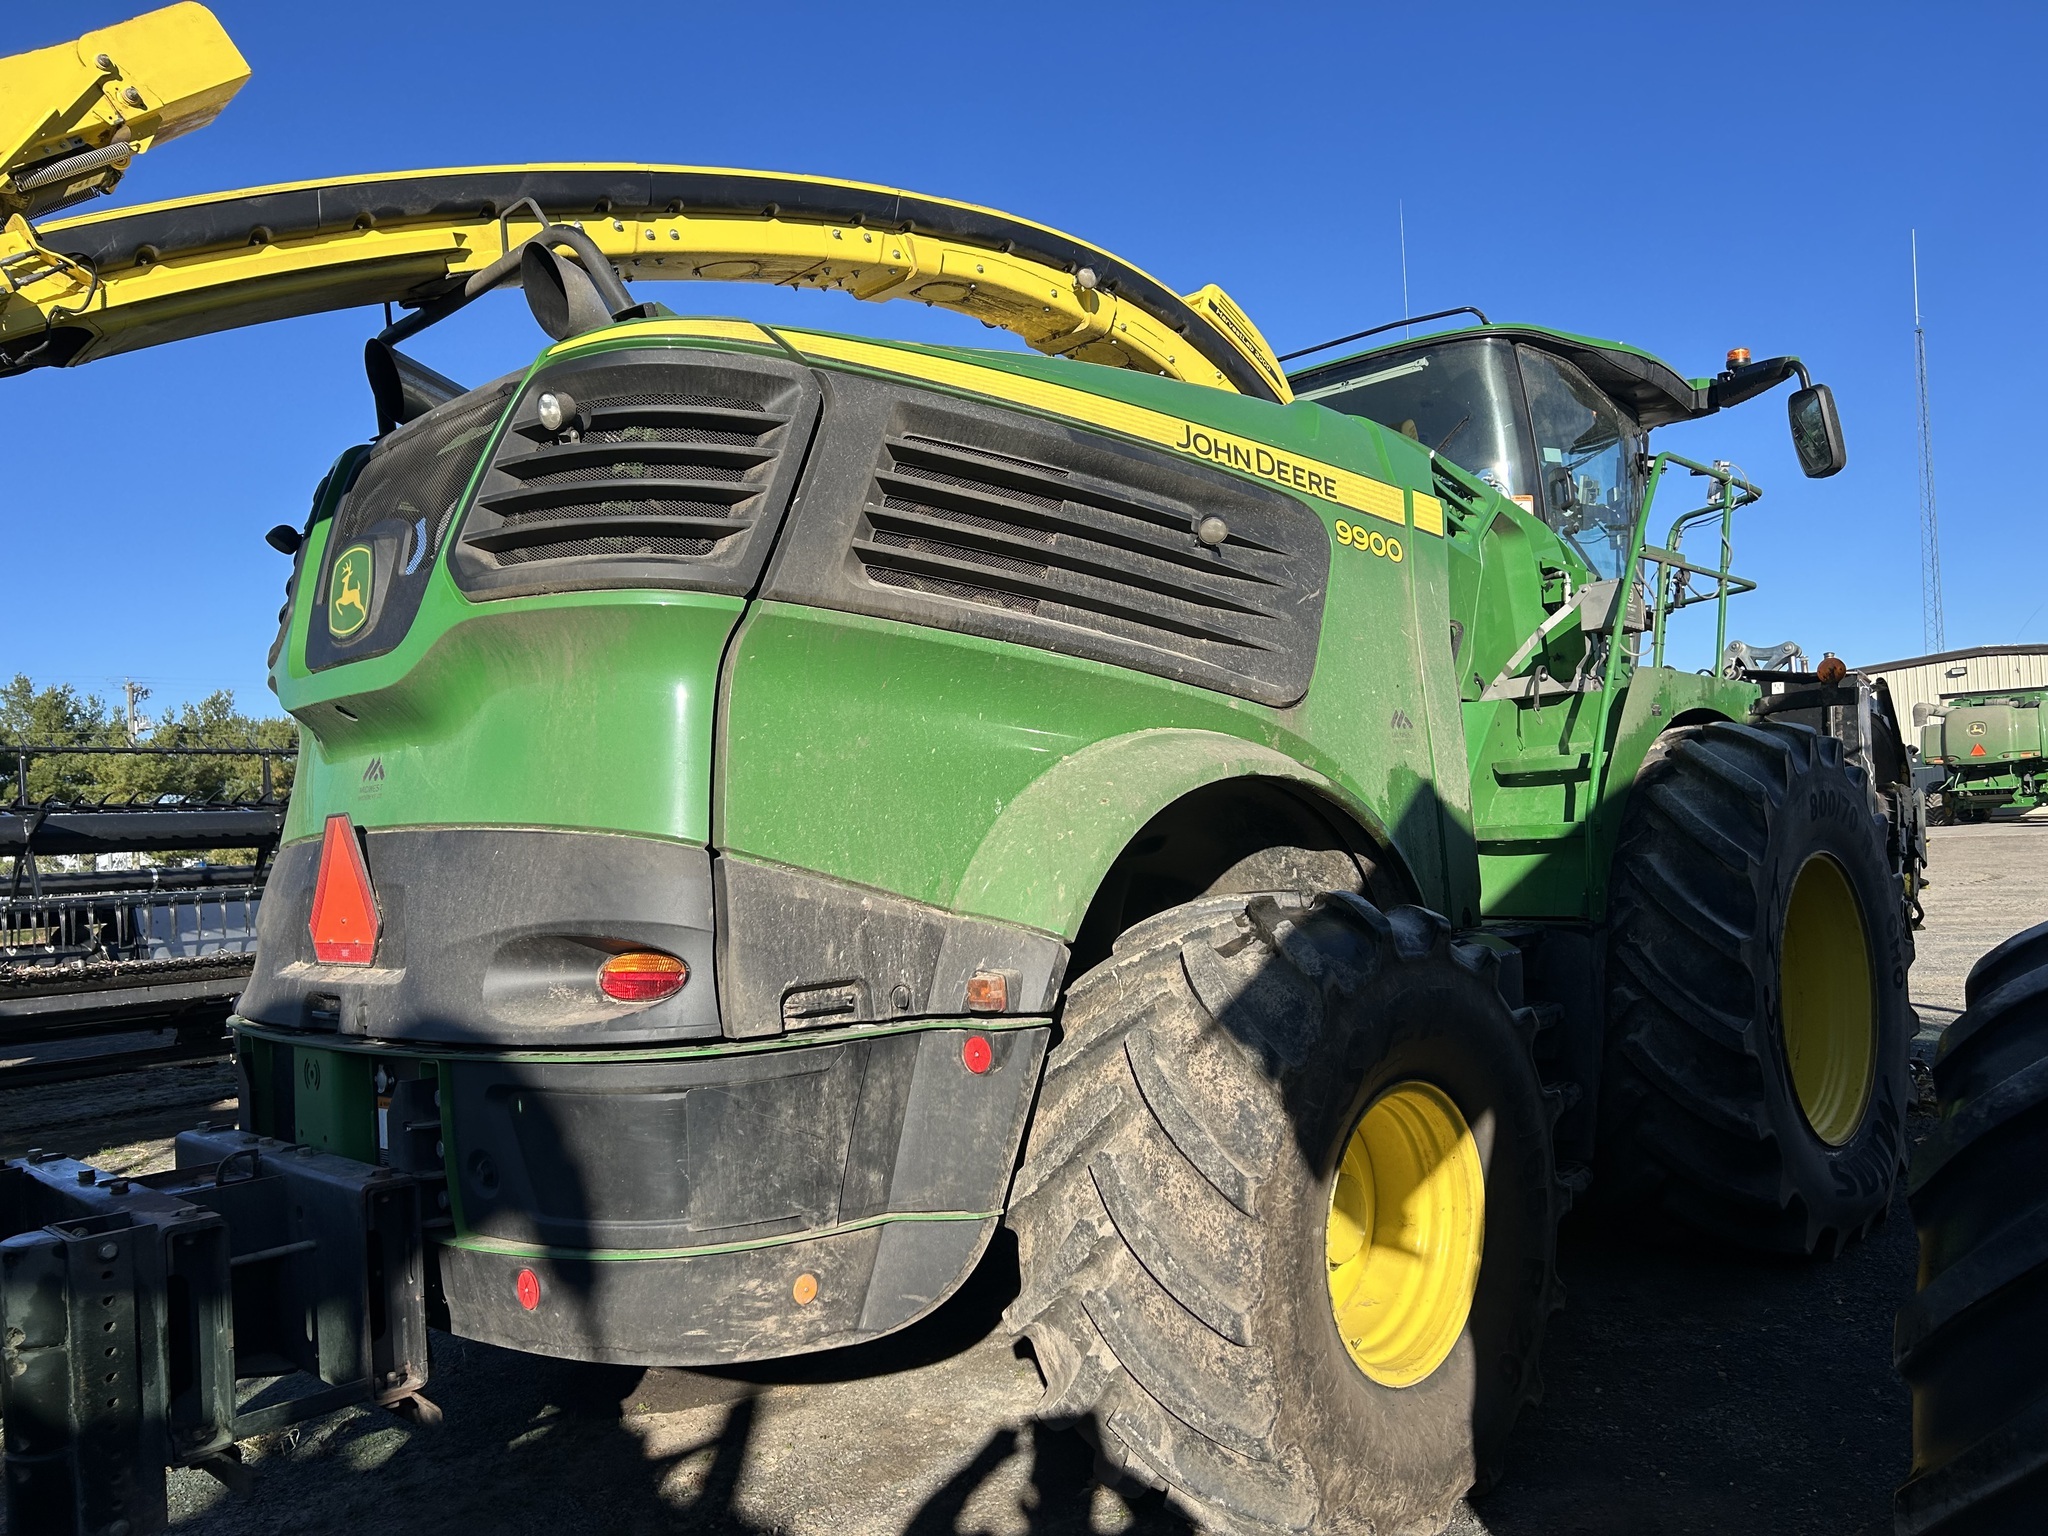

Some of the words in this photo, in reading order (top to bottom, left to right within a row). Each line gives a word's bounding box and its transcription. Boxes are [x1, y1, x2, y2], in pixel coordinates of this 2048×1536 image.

[1216, 309, 1254, 352] HarvestLab
[1177, 424, 1250, 470] JOHN
[1256, 447, 1338, 500] DEERE
[1334, 518, 1404, 563] 9900
[1810, 789, 1859, 833] 800/70
